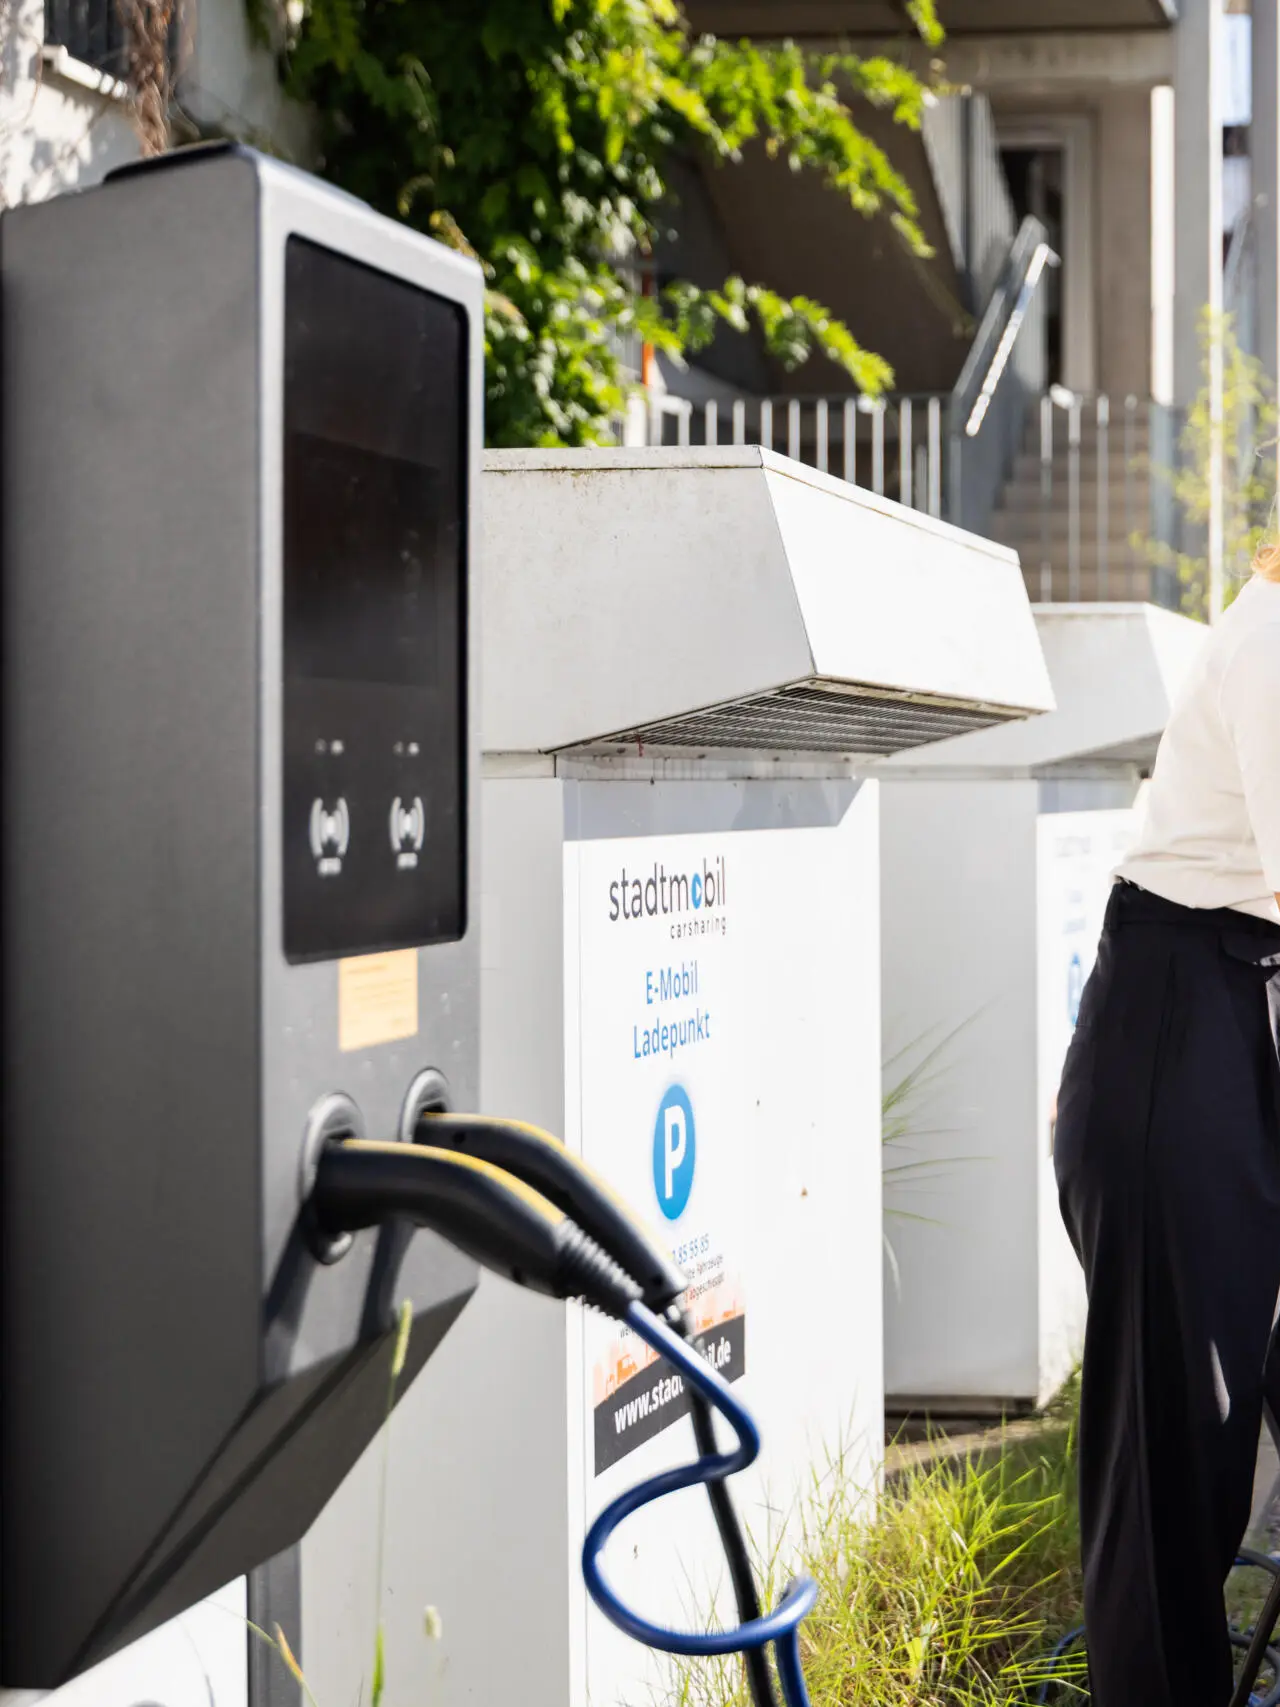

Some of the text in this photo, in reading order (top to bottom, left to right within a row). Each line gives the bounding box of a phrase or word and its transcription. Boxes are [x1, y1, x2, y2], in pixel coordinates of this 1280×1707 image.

[609, 856, 726, 922] stadtmobil
[670, 915, 726, 939] carsharing
[646, 960, 698, 1005] E-Mobil
[633, 1008, 710, 1059] Ladepunkt
[664, 1104, 687, 1200] P
